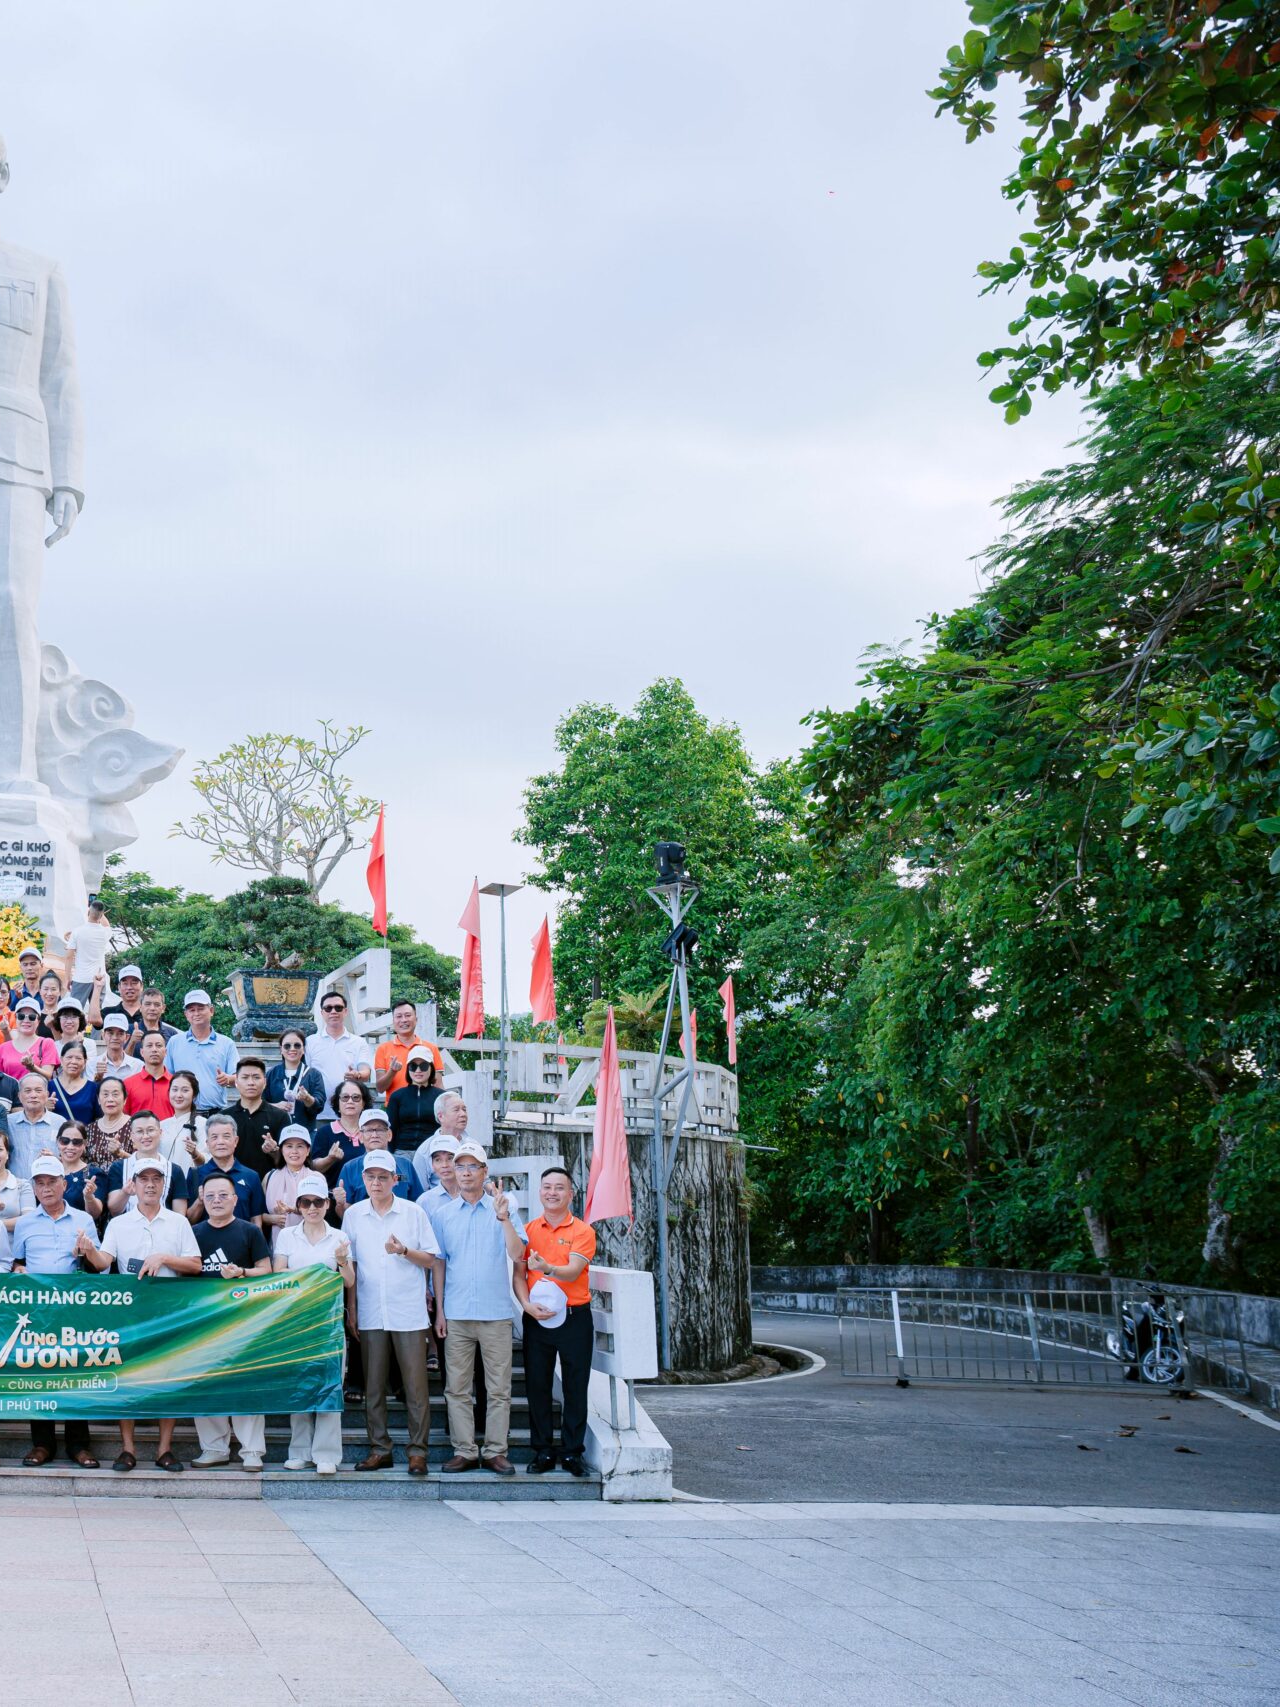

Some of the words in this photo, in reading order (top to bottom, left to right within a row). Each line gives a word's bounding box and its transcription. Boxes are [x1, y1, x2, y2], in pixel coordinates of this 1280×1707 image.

[26, 840, 51, 853] KHÓ
[252, 1279, 300, 1293] NAMHA
[37, 1286, 87, 1305] HÀNG
[90, 1291, 133, 1305] 2026
[61, 1326, 120, 1346] Bước
[83, 1347, 123, 1367] XA
[8, 1378, 43, 1390] CÙNG
[46, 1377, 74, 1390] PHÁT
[76, 1374, 107, 1389] TRIỂN
[6, 1398, 31, 1411] PHÚ
[34, 1400, 58, 1413] THỌ
